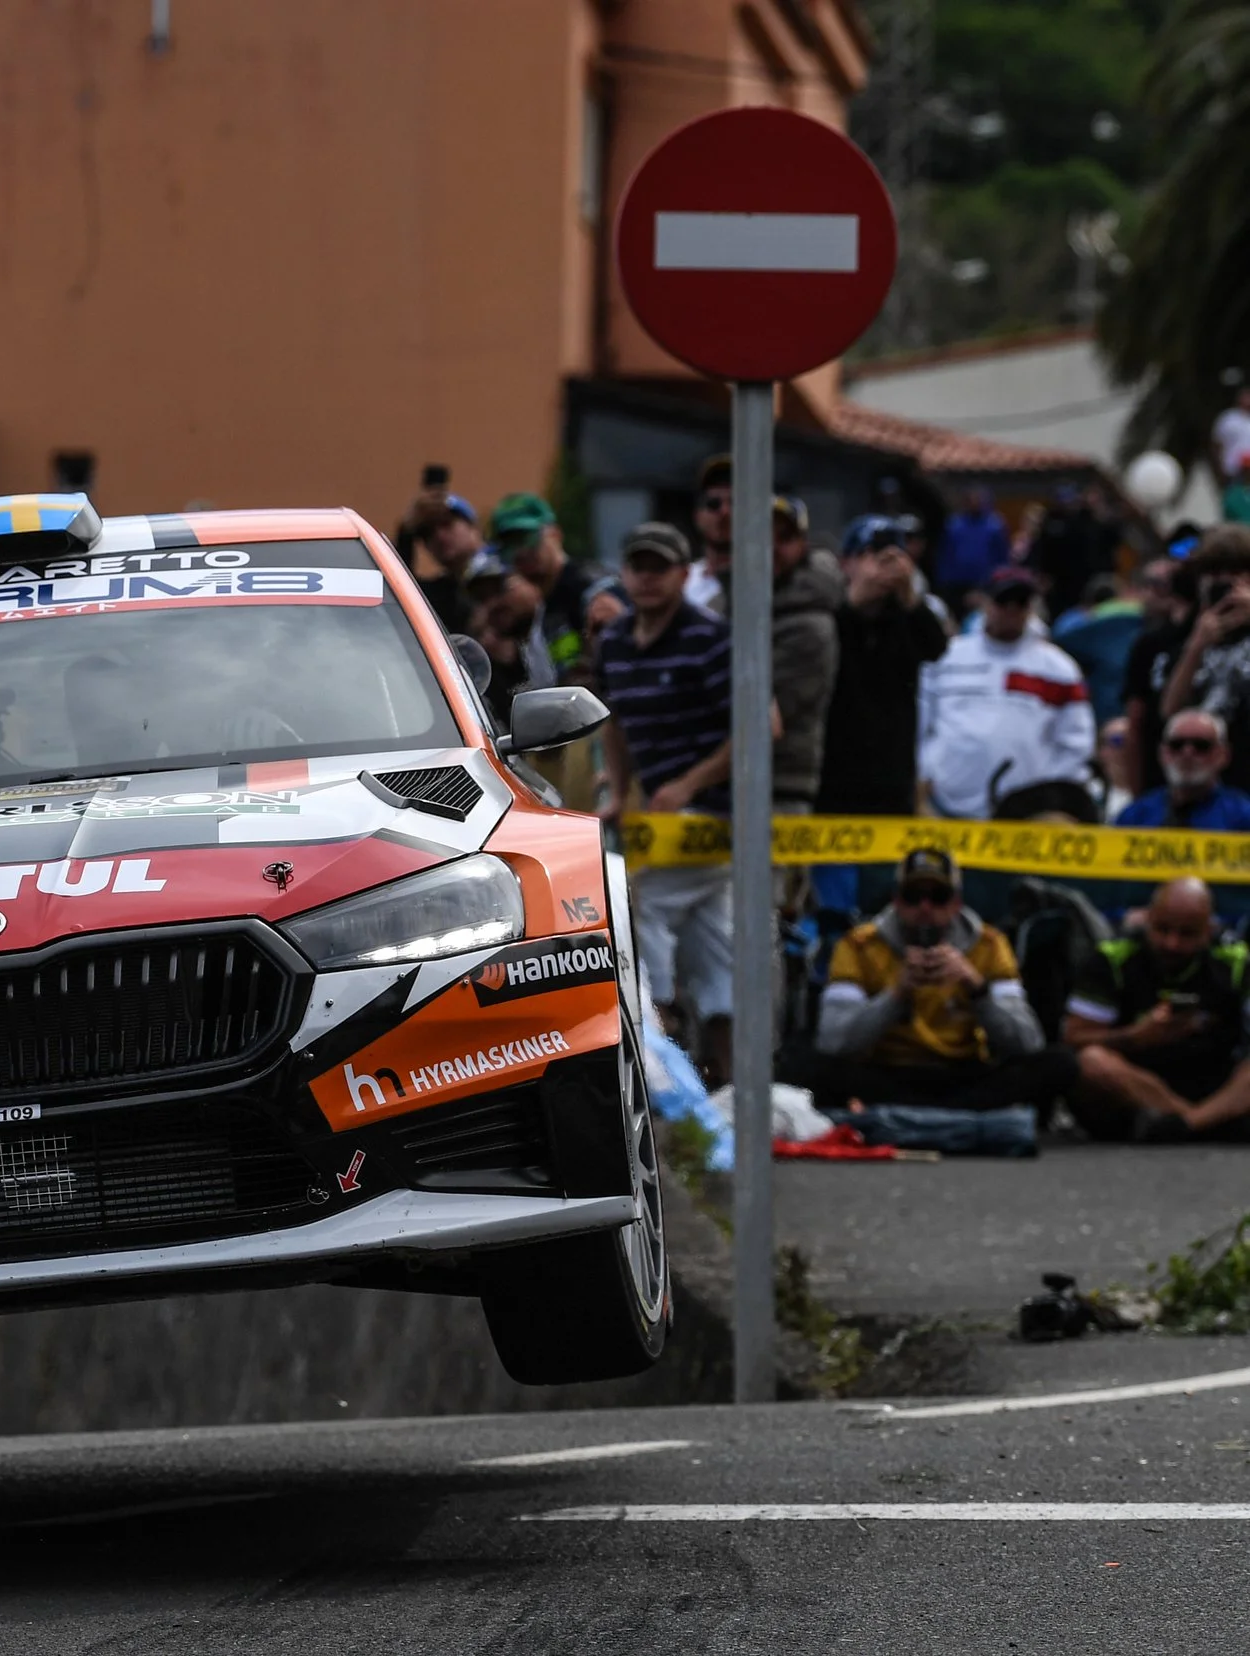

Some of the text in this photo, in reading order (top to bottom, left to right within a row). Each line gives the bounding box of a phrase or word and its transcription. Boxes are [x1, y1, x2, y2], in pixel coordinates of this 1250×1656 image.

[213, 804, 282, 814] AB
[1119, 834, 1200, 869] ZONA
[409, 1030, 570, 1093] HYRMASKINER
[0, 1106, 33, 1121] 109
